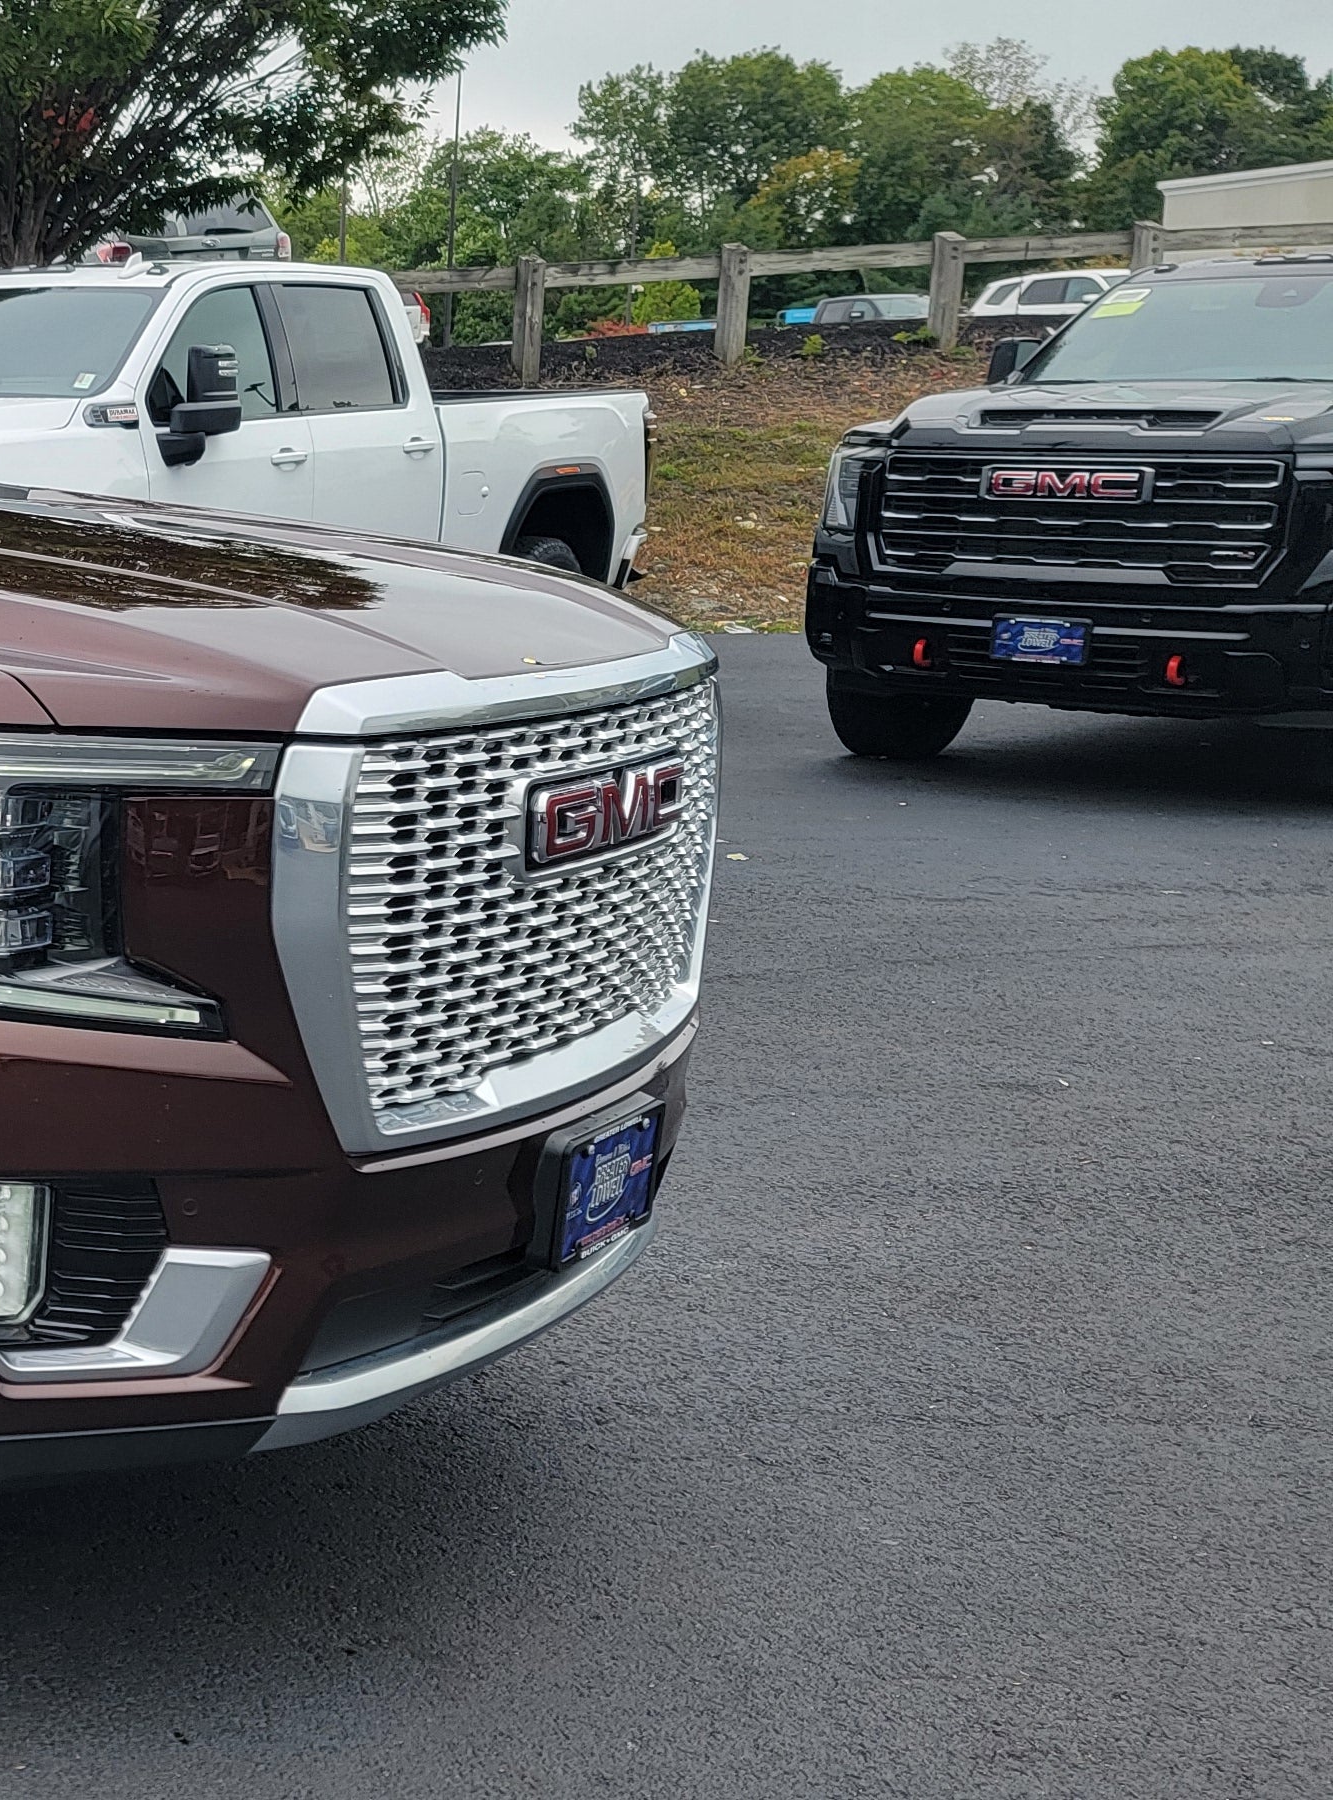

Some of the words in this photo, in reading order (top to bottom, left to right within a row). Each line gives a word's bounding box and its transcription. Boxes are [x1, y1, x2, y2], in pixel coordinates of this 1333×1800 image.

[991, 470, 1140, 498] GMC
[535, 757, 685, 863] GMC
[589, 1174, 626, 1210] LOWELL
[580, 1242, 606, 1260] BUICK
[610, 1226, 631, 1243] GMC
